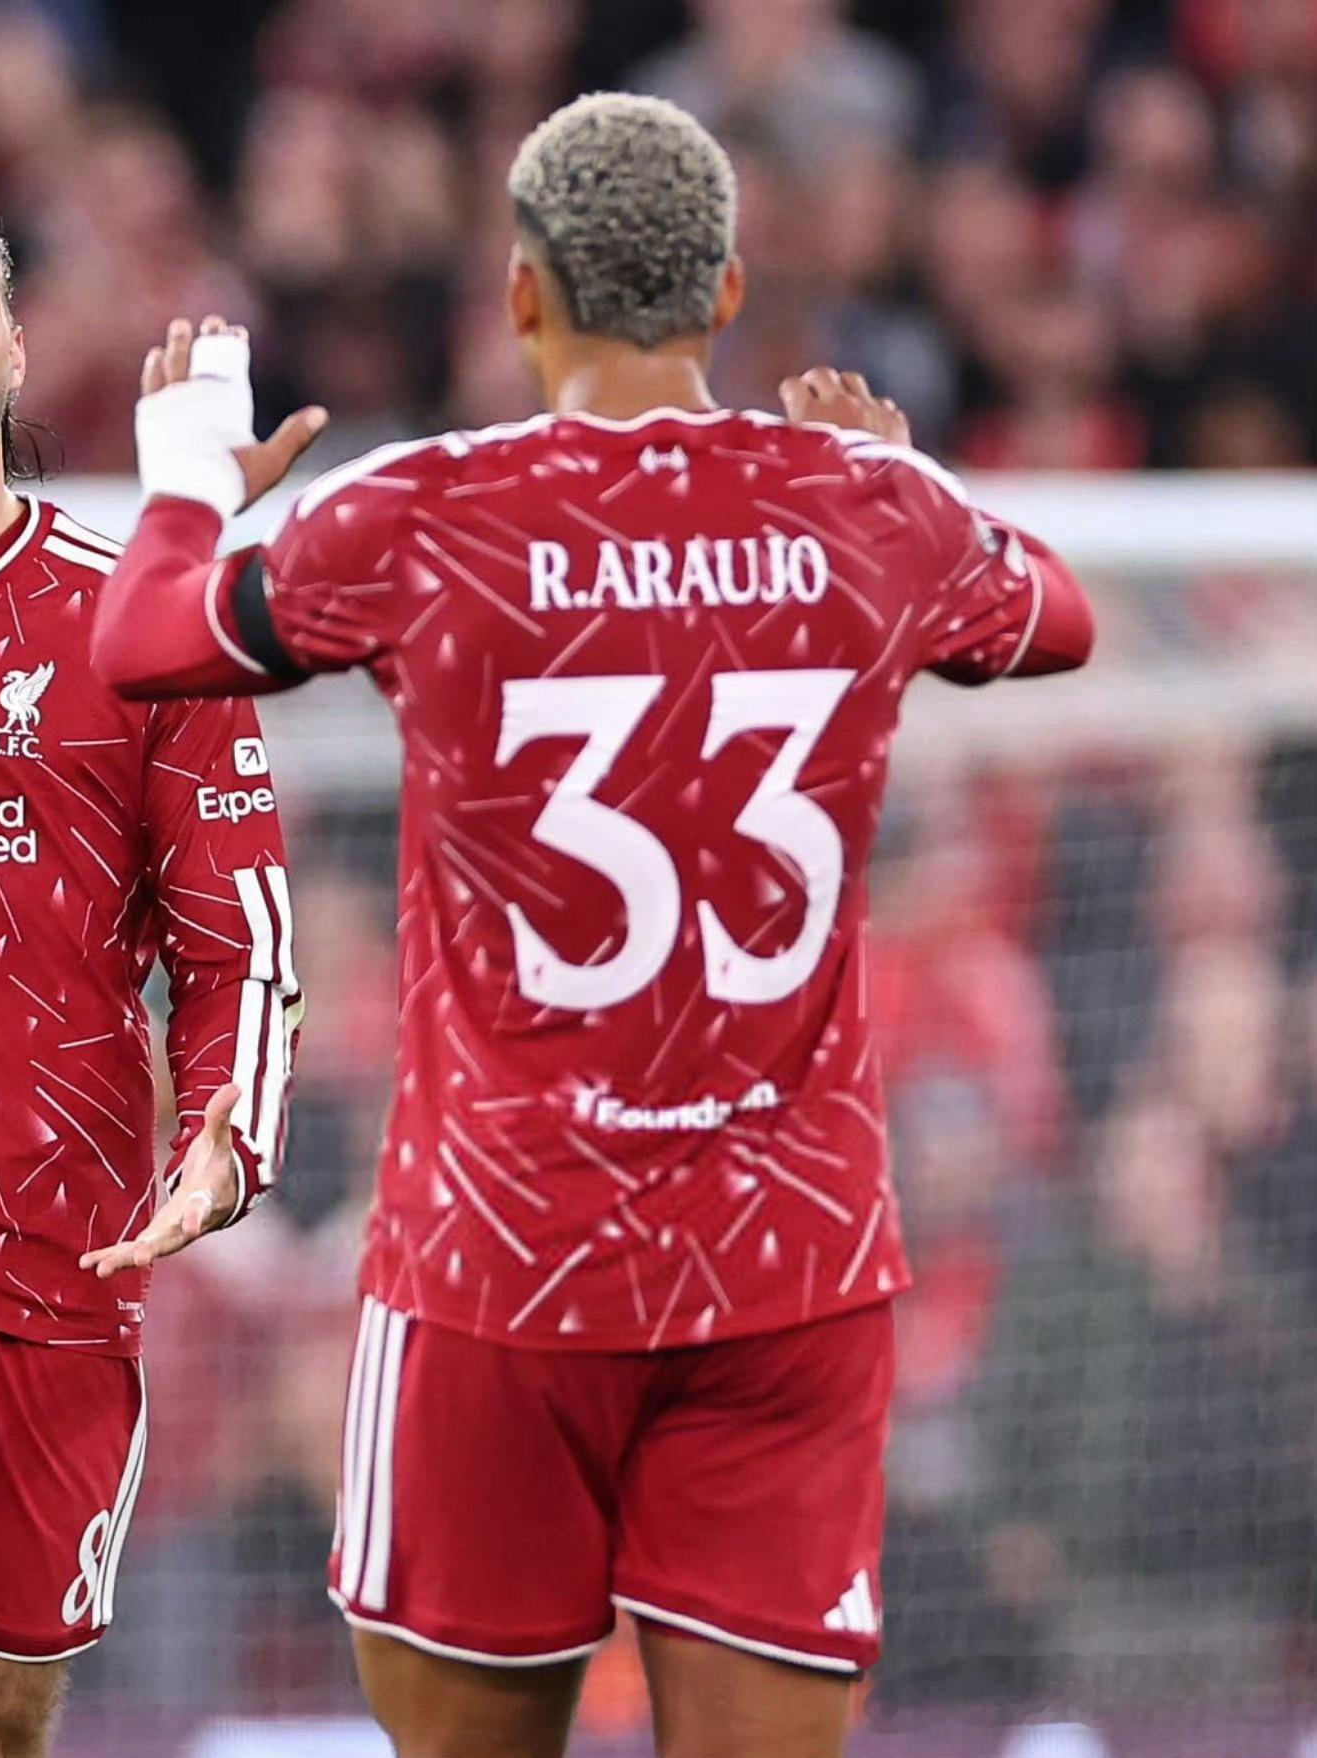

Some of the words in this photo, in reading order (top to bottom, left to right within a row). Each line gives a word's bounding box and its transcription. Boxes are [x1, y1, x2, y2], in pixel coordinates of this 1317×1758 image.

[529, 535, 829, 611] R.ARAUJO
[494, 669, 857, 1010] 33
[62, 1509, 109, 1626] 8
